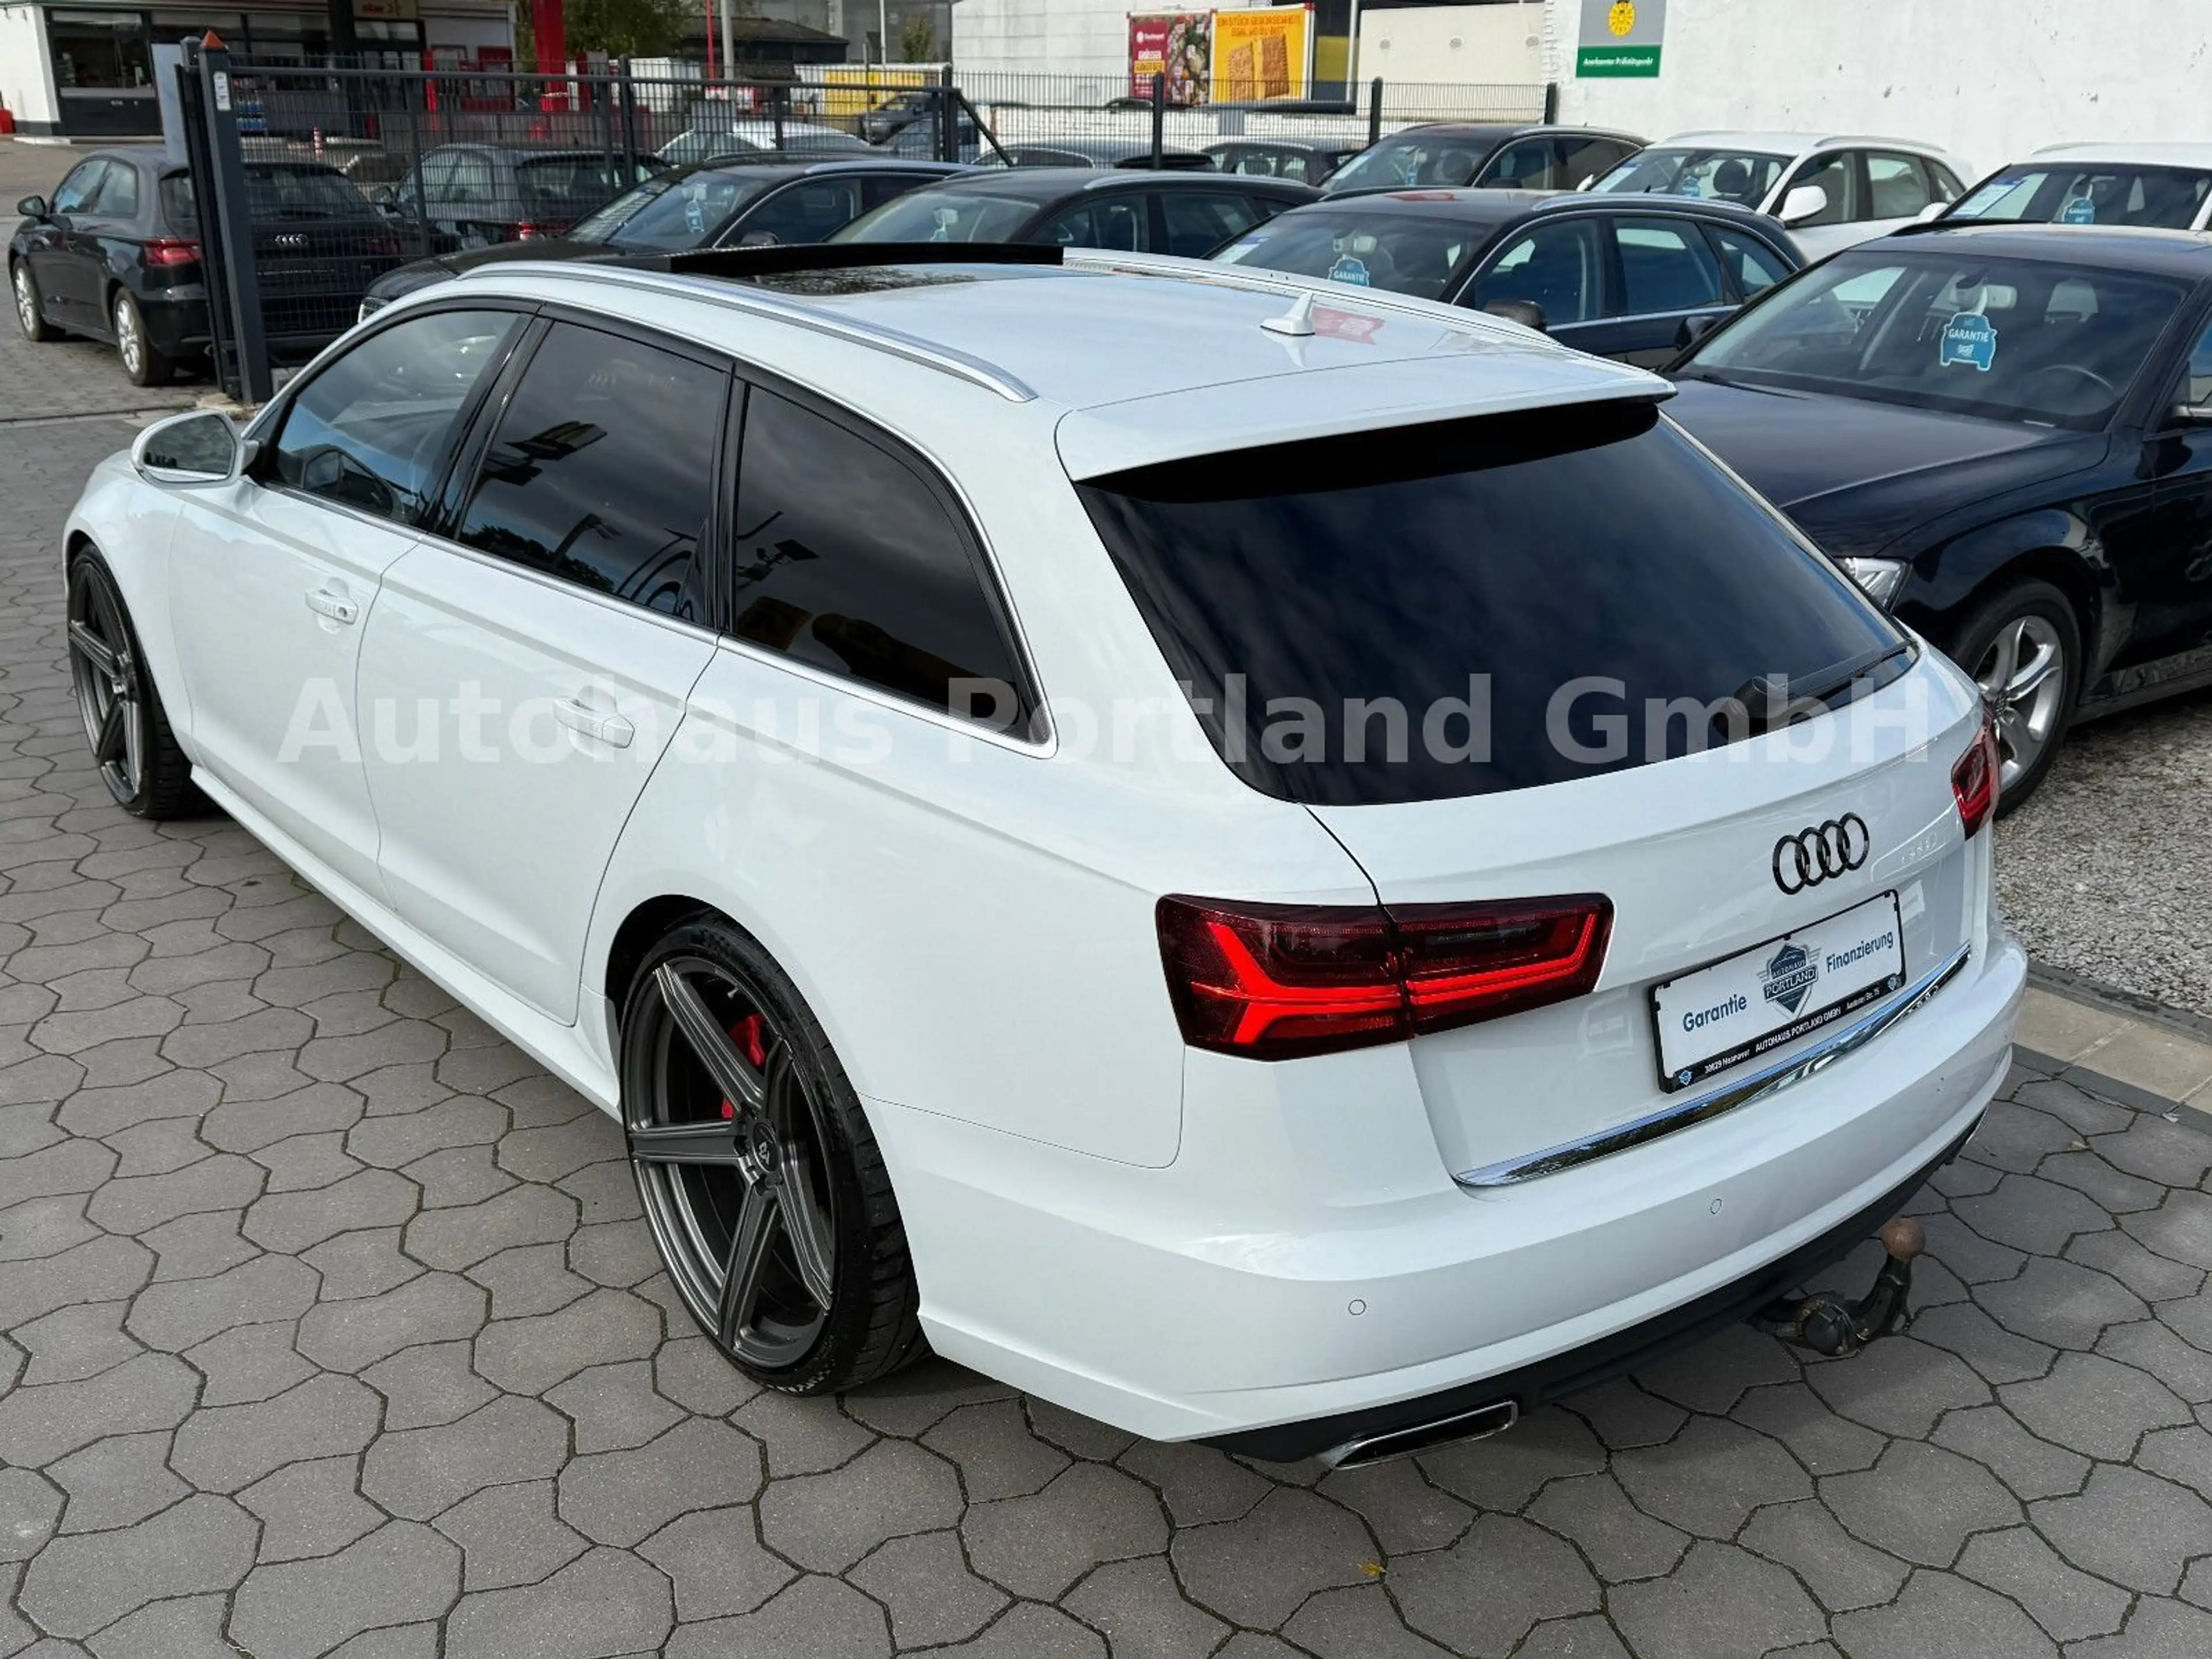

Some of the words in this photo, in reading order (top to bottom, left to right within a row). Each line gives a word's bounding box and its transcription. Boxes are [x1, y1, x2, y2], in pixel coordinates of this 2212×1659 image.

[1948, 328, 1990, 342] GARANTIE
[1827, 931, 1893, 974] Finanzierung
[1766, 969, 1815, 998] PORTLAND
[1683, 994, 1747, 1032] Garantie
[1755, 1029, 1790, 1053] AUTOHAUS
[1791, 1015, 1823, 1038] PORTLAND
